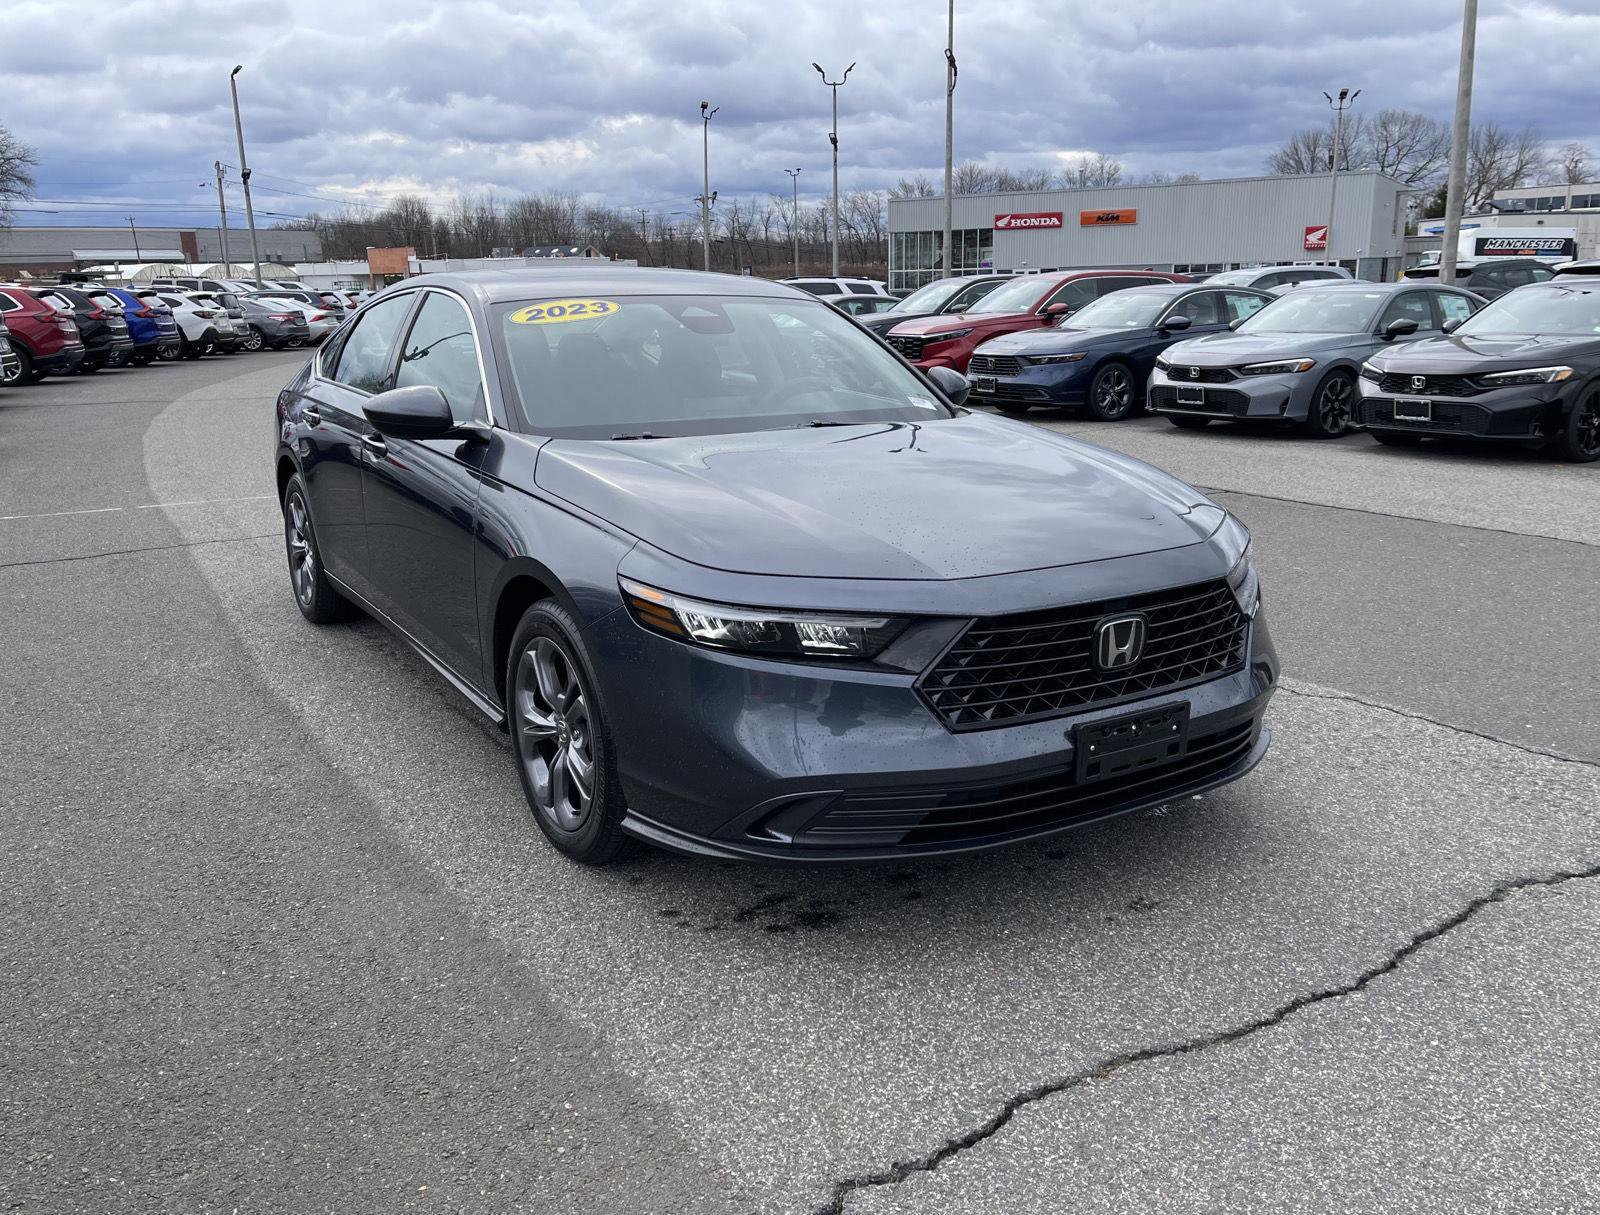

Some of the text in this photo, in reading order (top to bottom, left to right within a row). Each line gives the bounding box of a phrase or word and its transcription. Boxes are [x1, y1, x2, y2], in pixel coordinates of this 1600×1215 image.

[1010, 217, 1061, 227] HONDA
[1484, 239, 1565, 249] MANCHESTER
[525, 302, 610, 322] 2023
